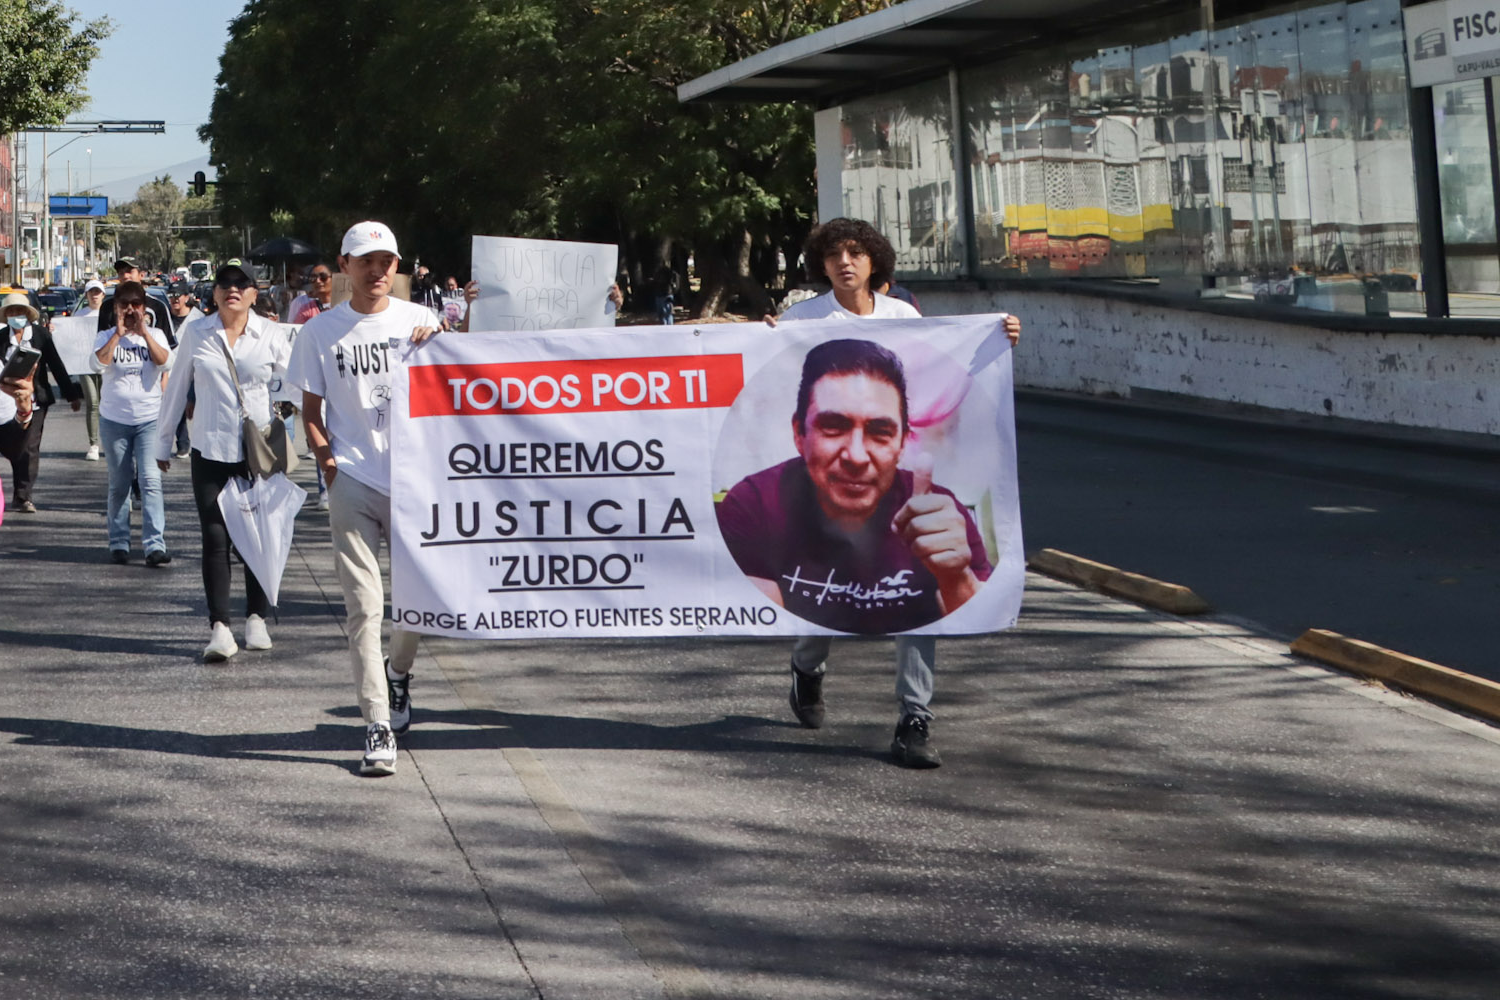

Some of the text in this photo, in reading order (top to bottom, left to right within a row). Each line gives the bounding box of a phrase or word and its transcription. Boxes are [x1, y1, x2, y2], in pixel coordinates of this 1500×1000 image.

[1453, 10, 1500, 42] FISC
[495, 246, 596, 287] JUSTICIA
[517, 287, 579, 314] PARA
[113, 345, 153, 363] JUSTICI
[351, 343, 389, 376] JUST
[448, 369, 708, 410] TODOS POR TI
[448, 438, 665, 475] QUEREMOS
[421, 498, 696, 540] JUSTICIA
[489, 553, 644, 587] "ZURDO"
[781, 565, 924, 606] Hollister
[392, 606, 778, 631] JORGE ALBERTO FUENTES SERRANO
